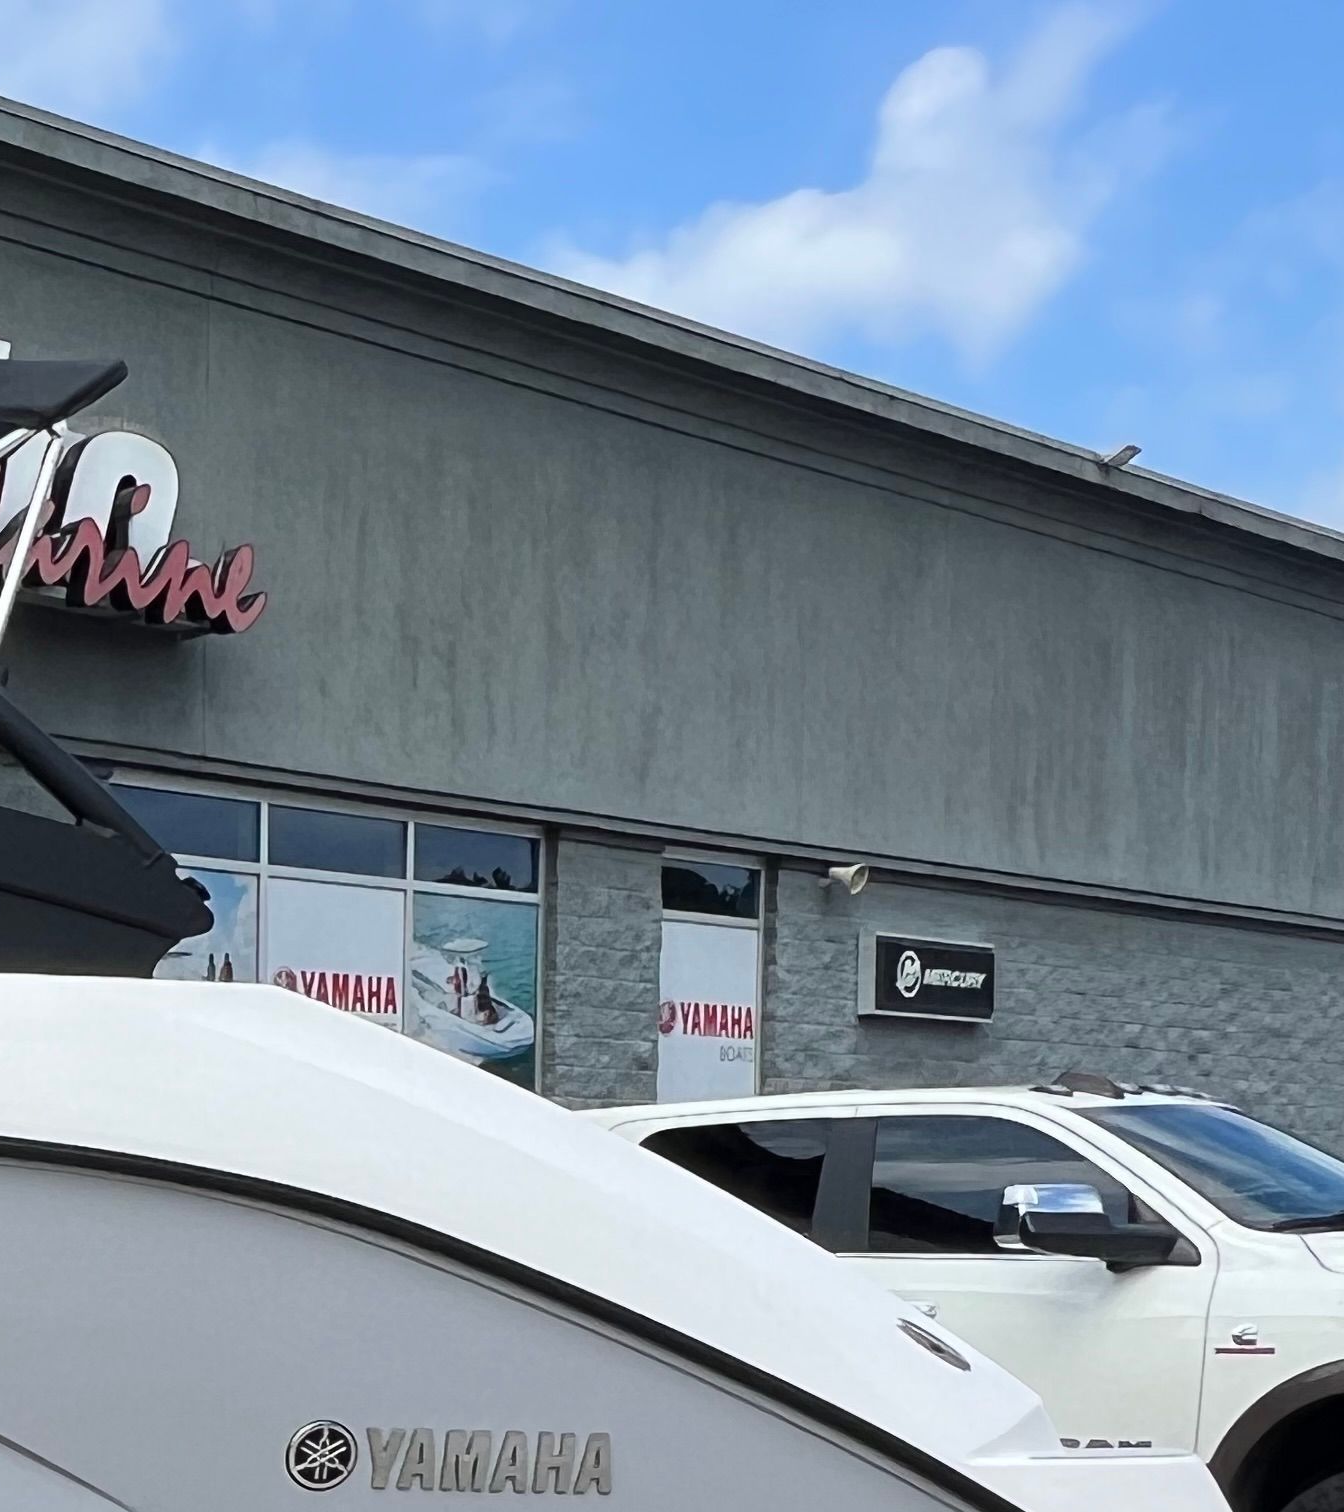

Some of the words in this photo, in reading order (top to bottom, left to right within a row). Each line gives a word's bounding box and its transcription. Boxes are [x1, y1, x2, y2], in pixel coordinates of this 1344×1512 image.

[300, 970, 398, 1014] YAMAHA
[923, 968, 987, 990] MERCURY
[680, 1002, 754, 1040] YAMAHA
[366, 1427, 612, 1496] YAMAHA
